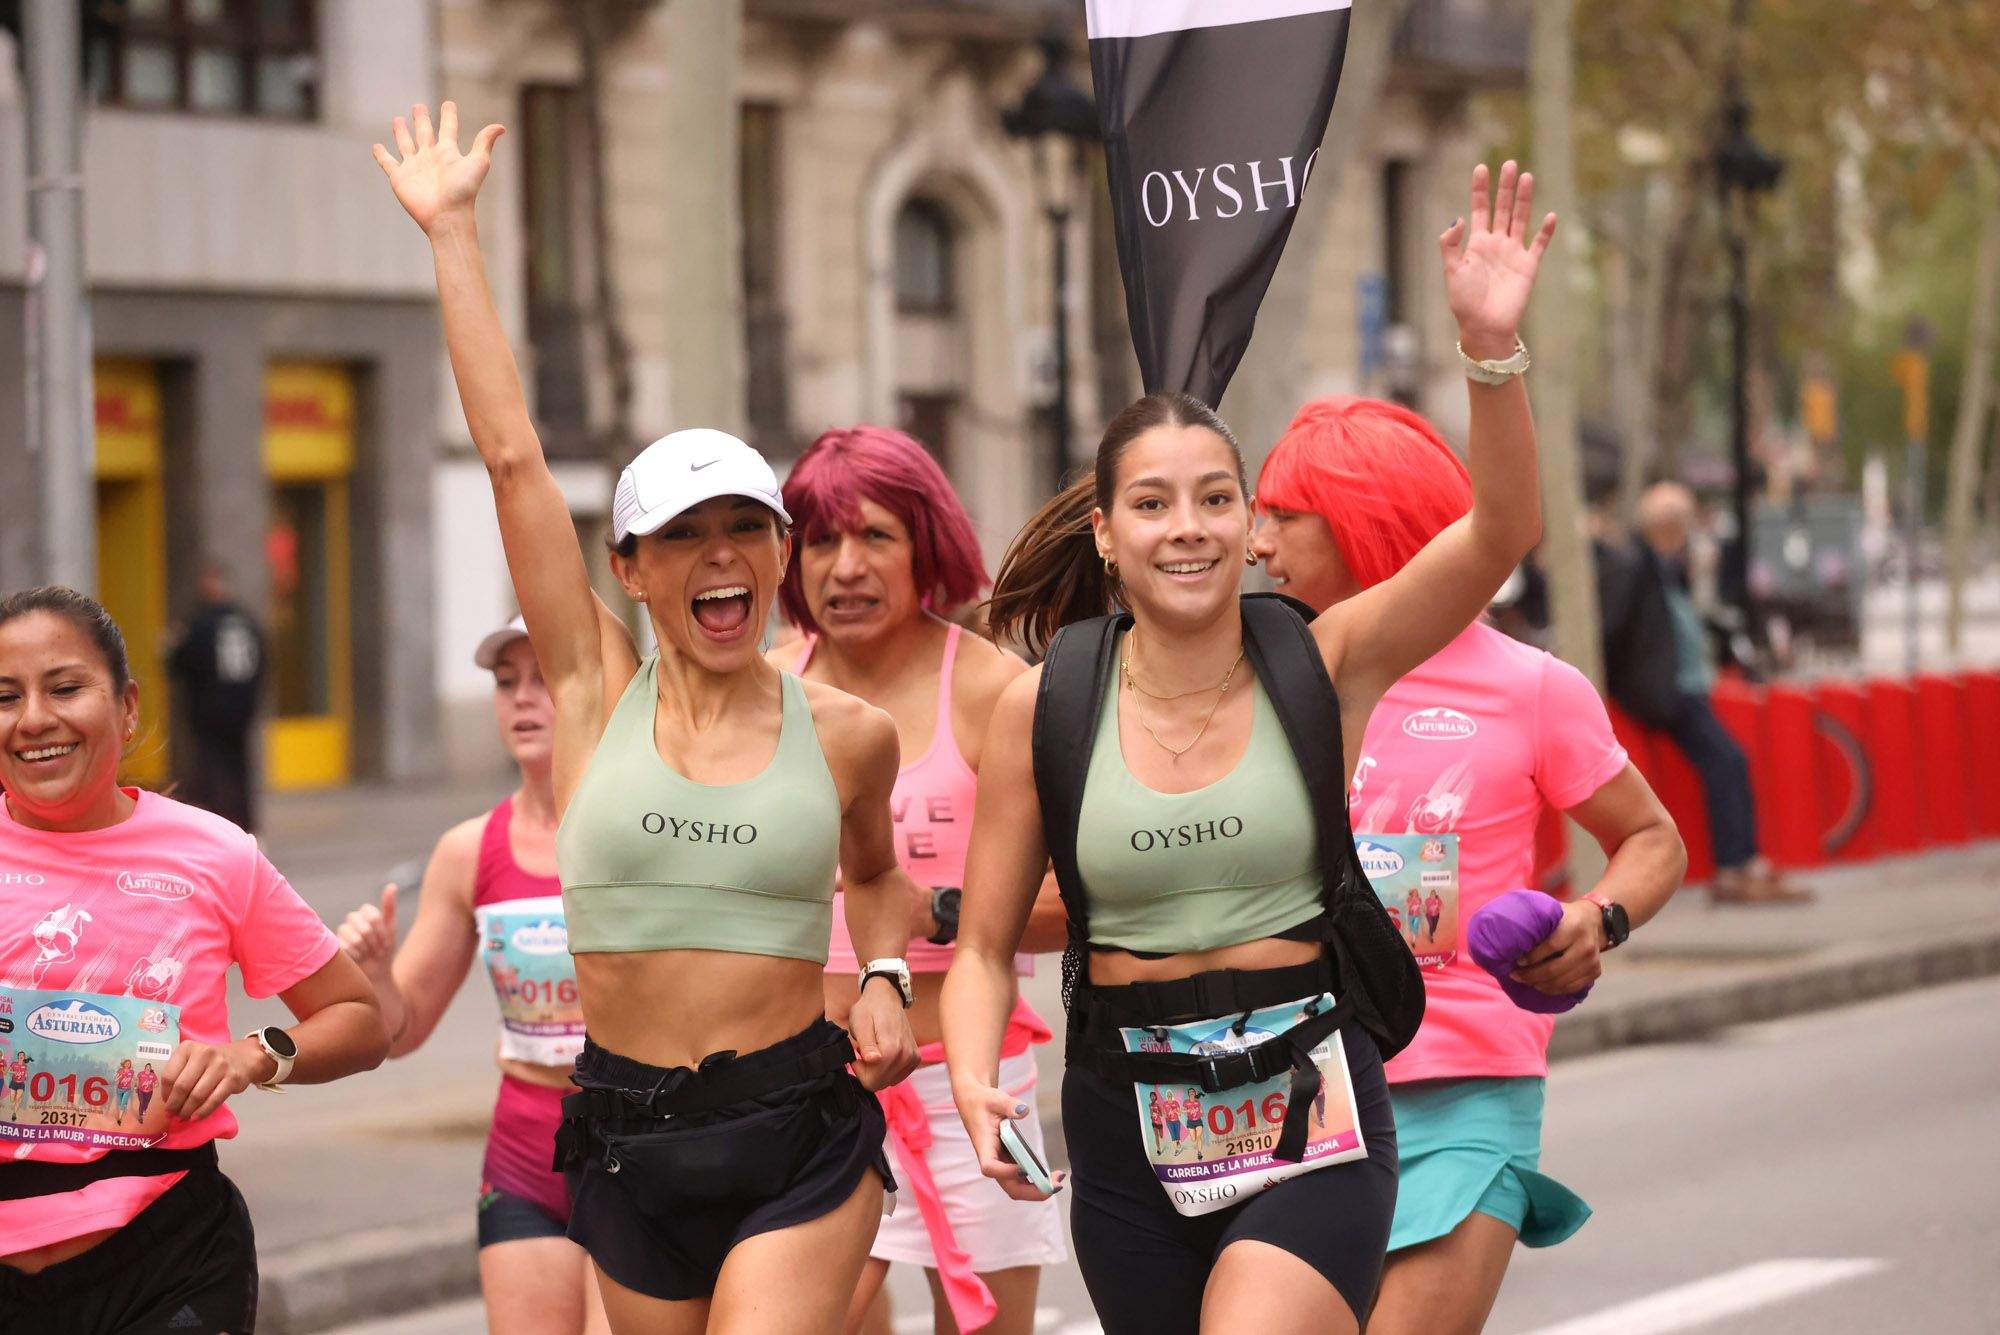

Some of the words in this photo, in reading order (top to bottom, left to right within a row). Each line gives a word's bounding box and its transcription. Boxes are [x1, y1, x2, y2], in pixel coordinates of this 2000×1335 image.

[641, 812, 758, 845] OYSHO
[1130, 816, 1243, 852] OYSHO
[0, 872, 45, 886] HO
[521, 978, 578, 1005] 016
[32, 1013, 114, 1036] ASTURIANA
[30, 1071, 110, 1107] 016
[40, 1111, 87, 1127] 20317
[1207, 1092, 1288, 1135] 016
[22, 1128, 36, 1139] DE
[38, 1129, 51, 1139] LA
[53, 1129, 85, 1142] MUJER
[1226, 1135, 1273, 1156] 21910
[1167, 1166, 1210, 1179] CARRERA
[1212, 1162, 1226, 1173] DE
[1228, 1159, 1241, 1171] LA
[1242, 1153, 1275, 1169] MUJER
[1174, 1183, 1237, 1205] OYSHO
